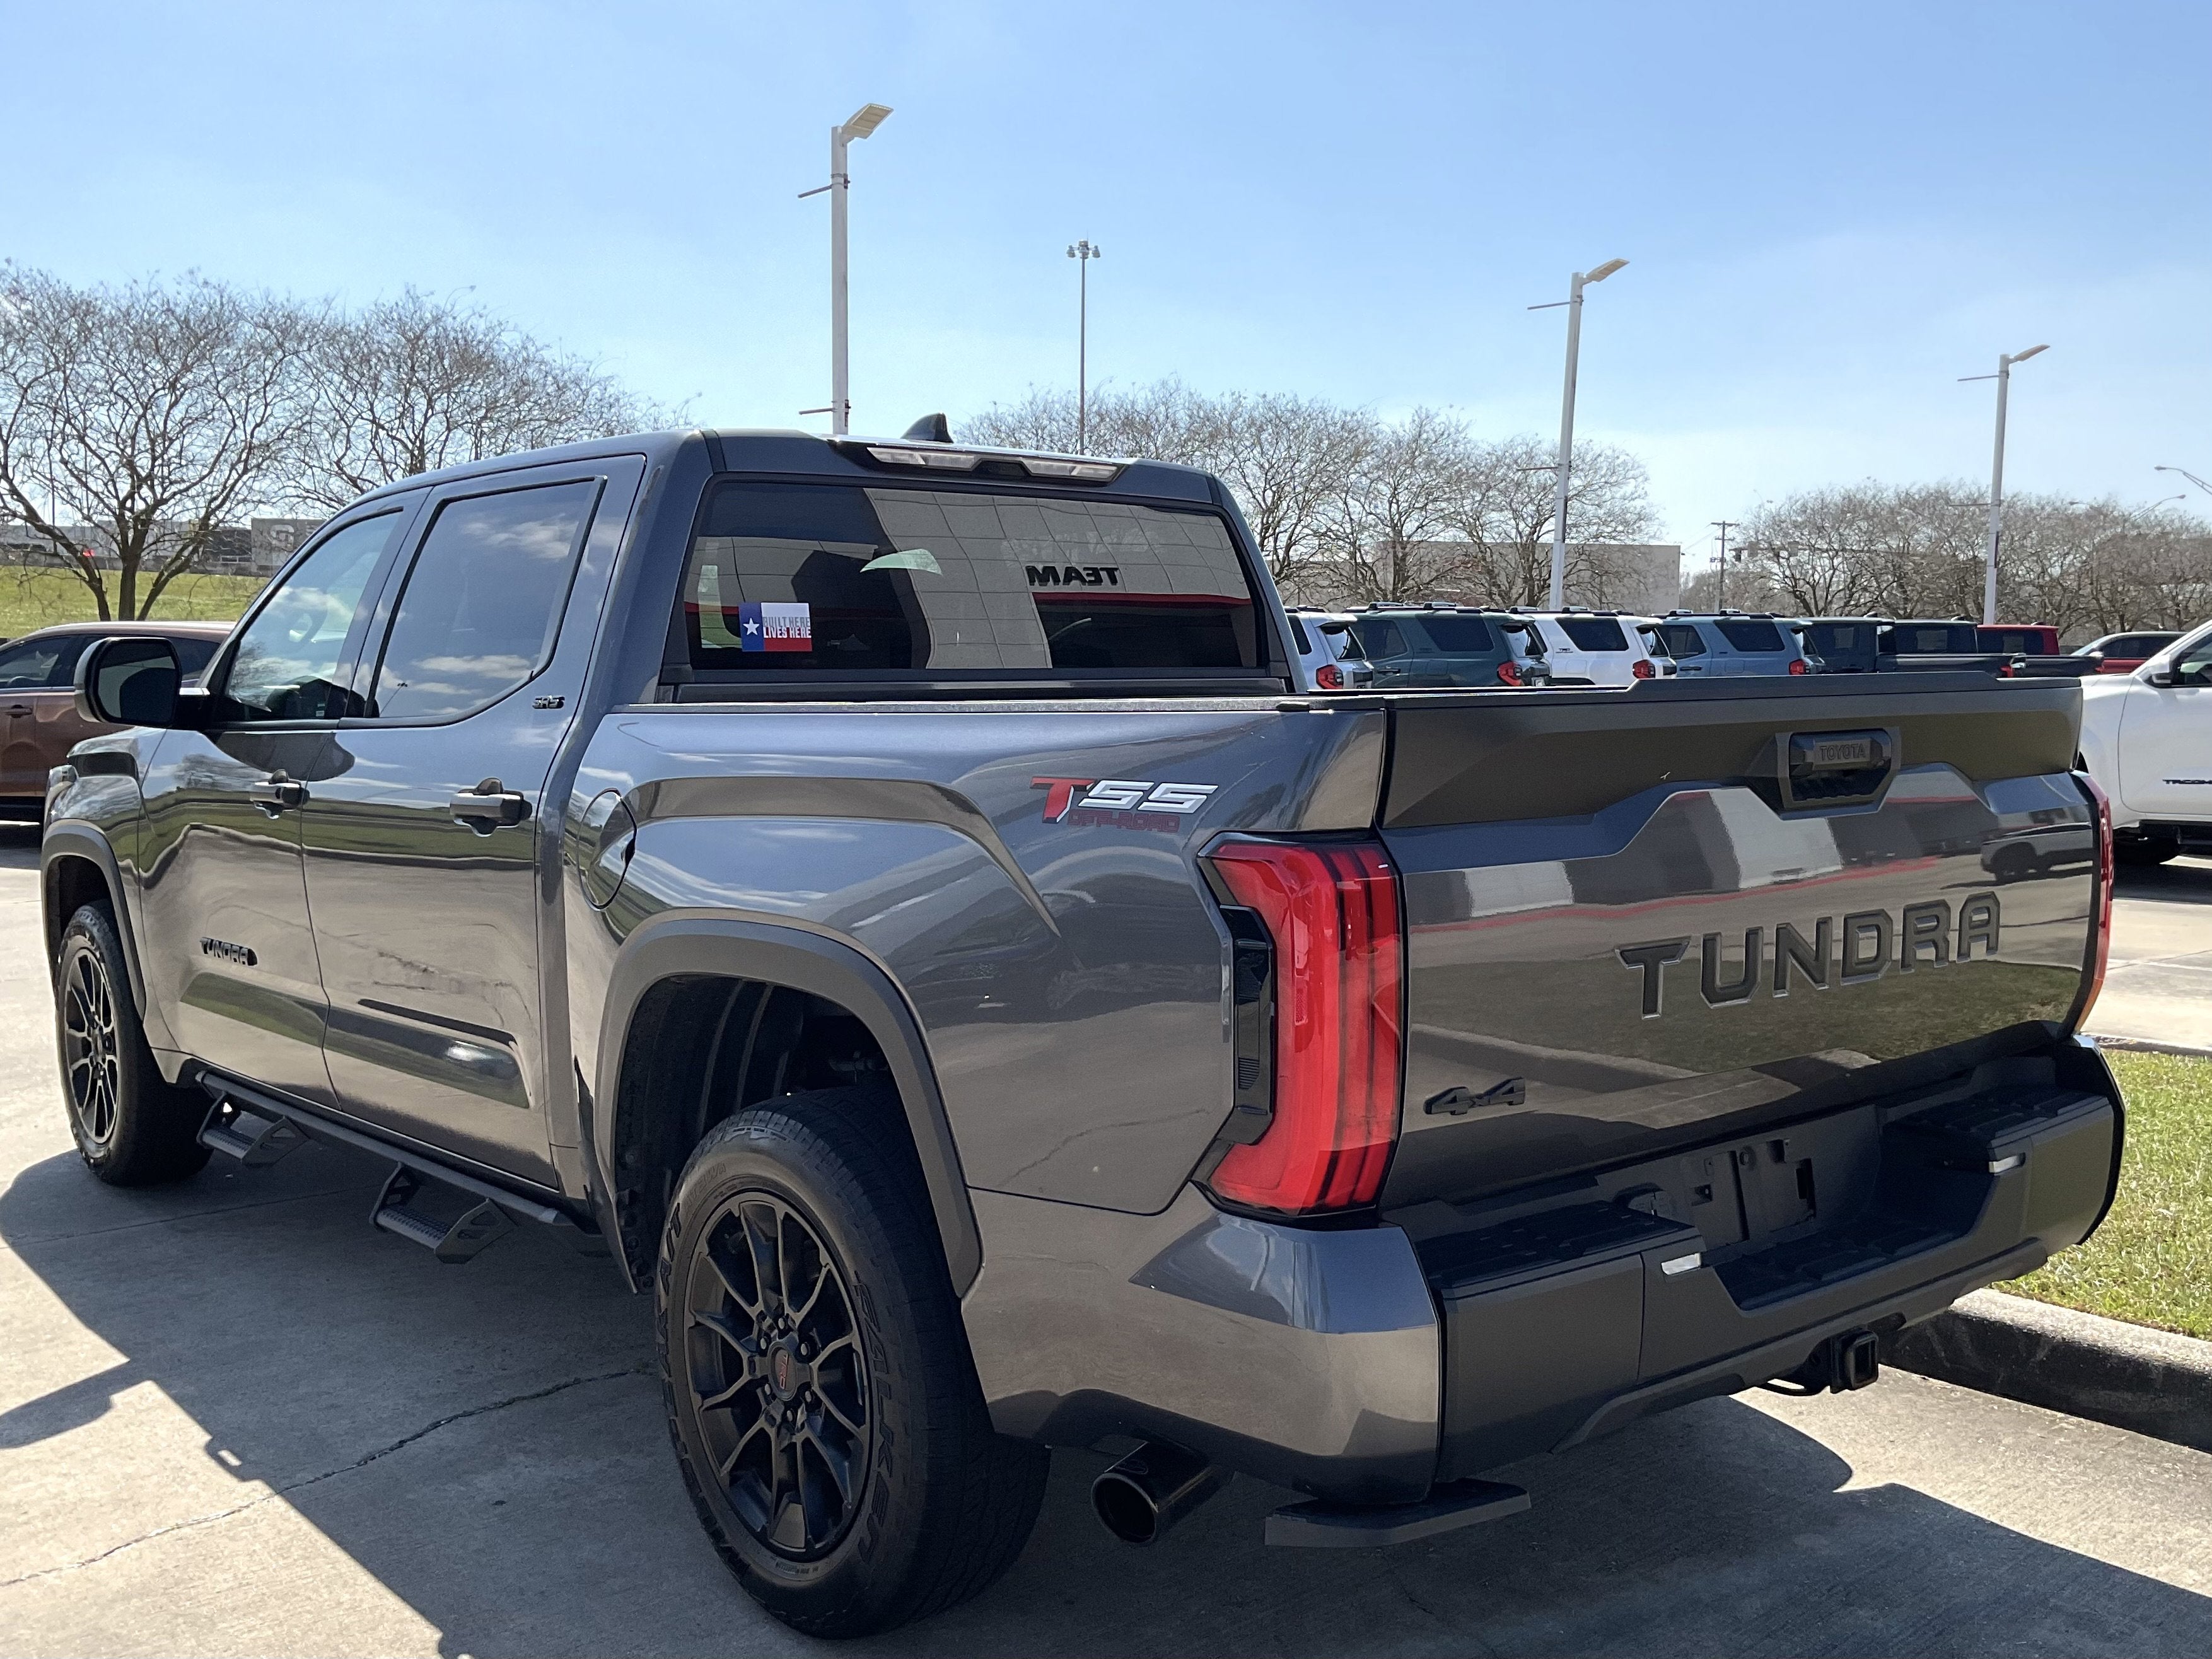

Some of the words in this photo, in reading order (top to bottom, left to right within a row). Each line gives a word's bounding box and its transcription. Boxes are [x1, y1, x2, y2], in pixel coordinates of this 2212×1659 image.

[762, 617, 788, 627] BUILT
[788, 617, 810, 627] HERE
[763, 626, 788, 638] LIVES
[789, 626, 812, 638] HERE
[1820, 743, 1866, 761] TOYOTA
[1030, 776, 1219, 824] TSS
[199, 936, 258, 966] TUNDRA
[1614, 891, 2001, 1020] TUNDRA
[779, 1353, 789, 1389] TRD
[853, 1271, 894, 1563] FALKEN
